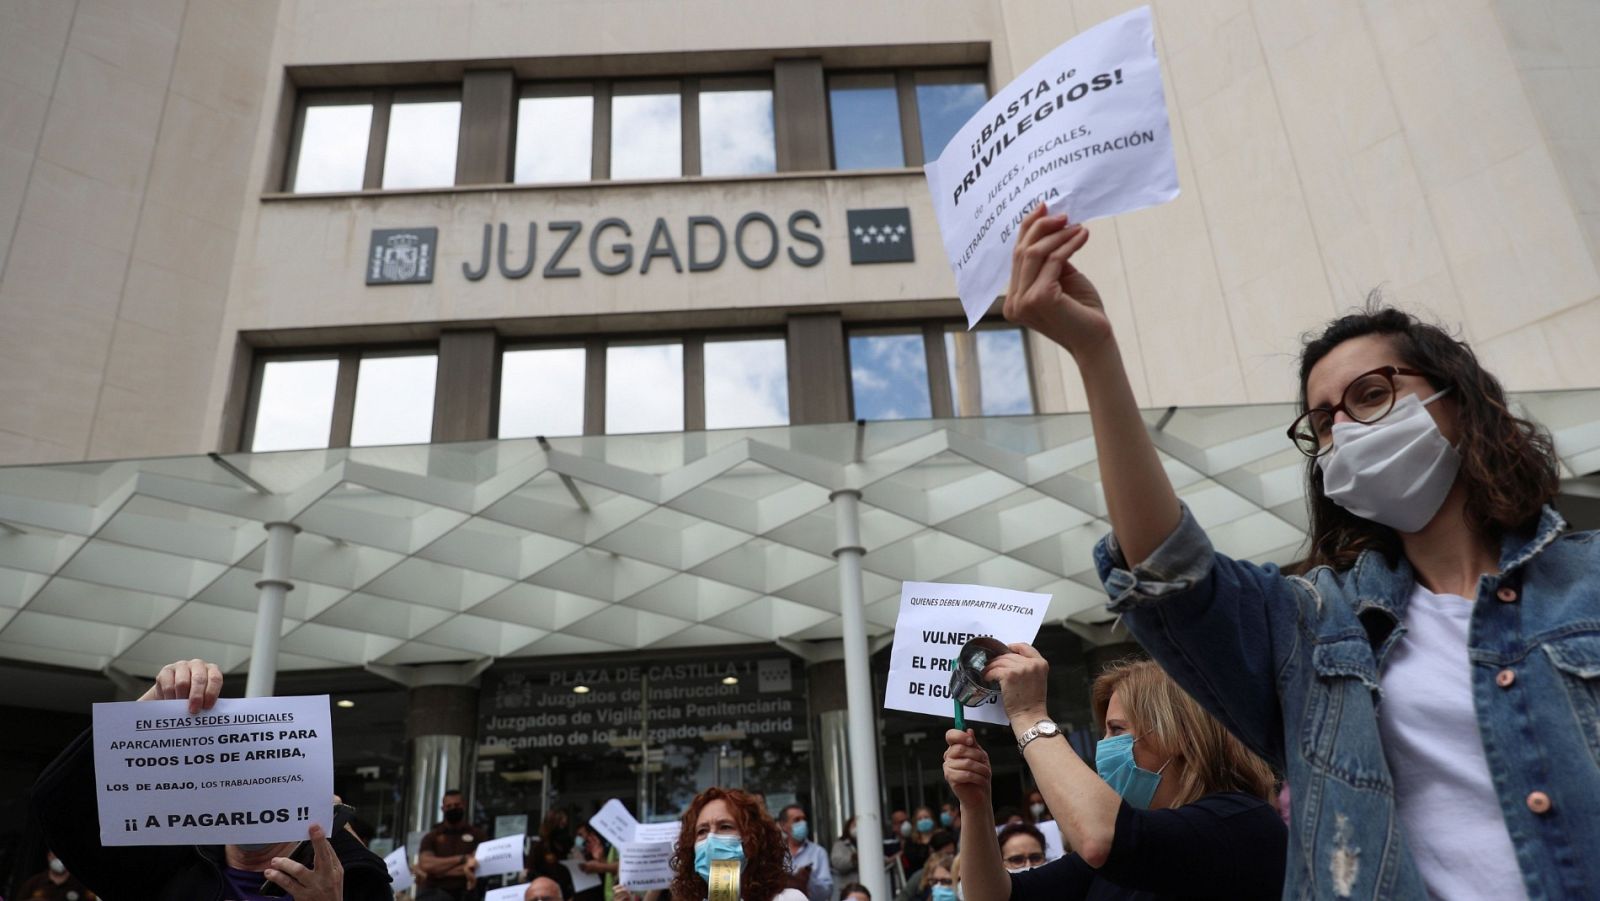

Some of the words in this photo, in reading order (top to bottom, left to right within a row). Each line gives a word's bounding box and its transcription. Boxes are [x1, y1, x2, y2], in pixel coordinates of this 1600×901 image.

[971, 80, 1051, 159] ¡¡BASTA
[1056, 67, 1077, 85] de
[953, 68, 1123, 206] PRIVILEGIOS!
[974, 204, 984, 219] de
[1027, 125, 1092, 162] FISCALES,
[957, 261, 963, 270] Y
[962, 215, 995, 264] LETRADOS
[995, 198, 1007, 217] DE
[1009, 186, 1021, 202] LA
[1023, 129, 1154, 189] ADMINISTRACIÓN
[1000, 224, 1011, 244] DE
[462, 210, 825, 282] JUZGADOS
[910, 597, 939, 606] QUIENES
[939, 599, 961, 607] DEBEN
[961, 599, 997, 609] IMPARTIR
[998, 603, 1034, 616] JUSTICIA
[550, 667, 610, 686] PLAZA
[615, 667, 640, 683] DE
[649, 661, 738, 681] CASTILLA
[911, 656, 926, 669] EL
[537, 685, 616, 707] Juzgados
[621, 686, 641, 702] de
[648, 682, 740, 700] Instrucción
[909, 682, 925, 695] DE
[136, 720, 152, 730] EN
[155, 717, 192, 728] ESTAS
[195, 715, 230, 726] SEDES
[232, 712, 294, 724] JUDICIALES
[486, 708, 567, 731] Juzgados
[571, 708, 592, 726] de
[686, 696, 792, 718] Penitenciaria
[110, 736, 215, 750] APARCAMIENTOS
[217, 731, 275, 744] GRATIS
[278, 729, 318, 740] PARA
[486, 731, 564, 750] Decanato
[567, 728, 588, 745] de
[592, 727, 617, 744] los
[737, 716, 793, 735] Madrid
[125, 756, 179, 768] TODOS
[184, 753, 215, 765] LOS
[220, 751, 240, 763] DE
[245, 747, 306, 761] ARRIBA,
[106, 783, 129, 792] LOS
[136, 782, 152, 791] DE
[154, 780, 198, 791] ABAJO,
[201, 780, 218, 789] LOS
[145, 815, 161, 828] A
[168, 807, 290, 828] PAGARLOS
